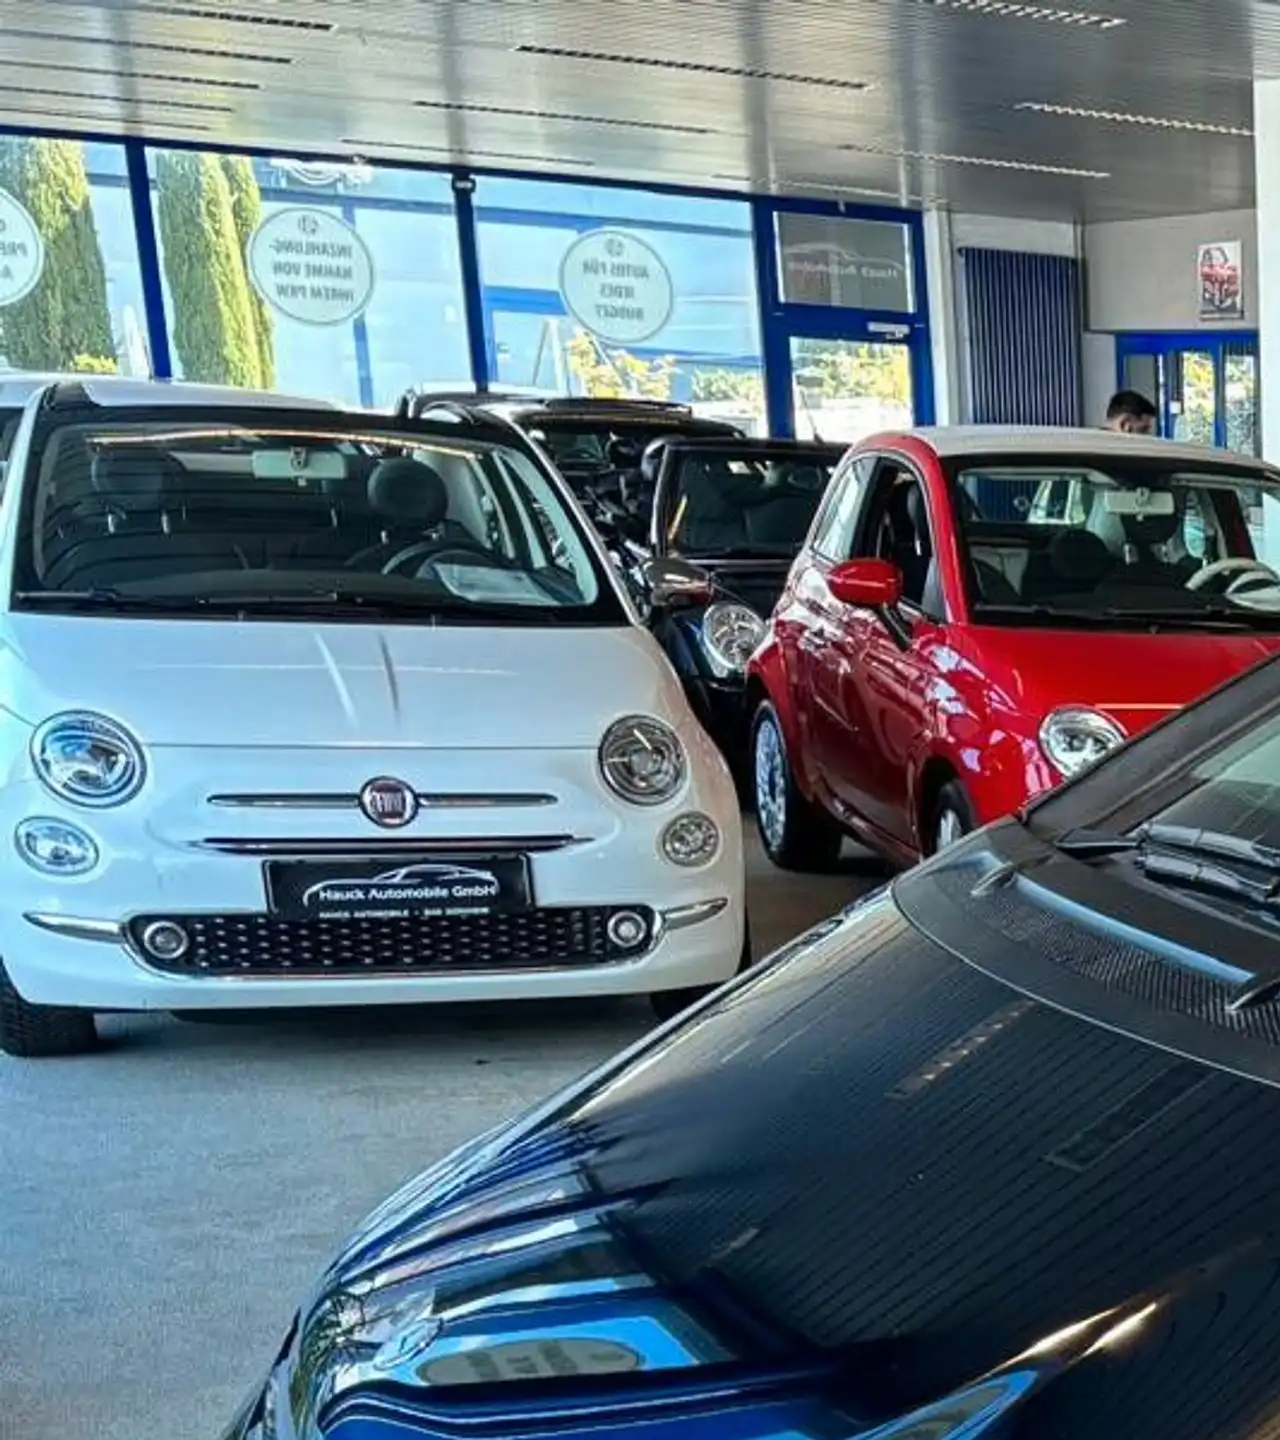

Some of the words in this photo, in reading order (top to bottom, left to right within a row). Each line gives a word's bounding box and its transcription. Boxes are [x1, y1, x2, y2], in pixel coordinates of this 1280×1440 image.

[318, 886, 366, 901] Hauck
[367, 884, 450, 900] Automobile
[451, 884, 497, 898] GmbH
